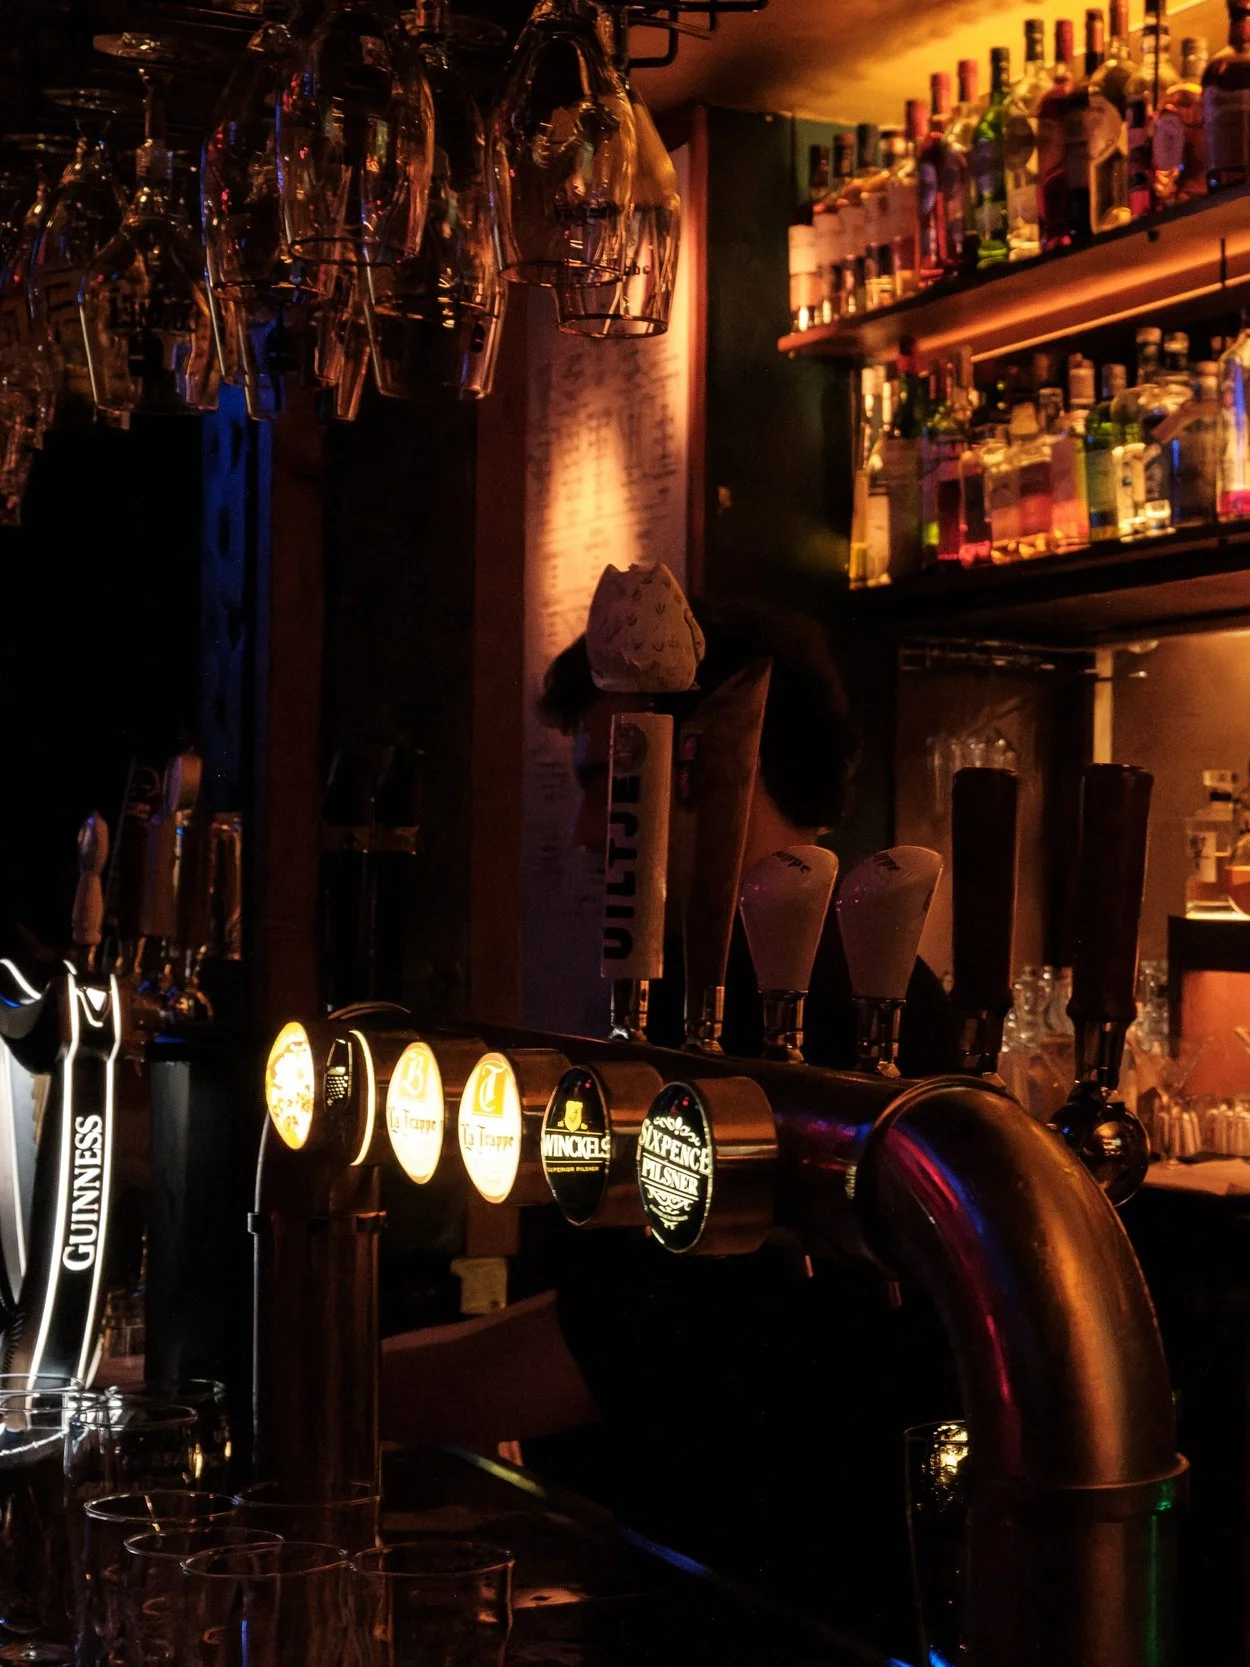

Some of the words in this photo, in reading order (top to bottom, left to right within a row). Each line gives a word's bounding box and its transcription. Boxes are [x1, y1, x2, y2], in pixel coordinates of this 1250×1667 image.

[603, 776, 640, 959] UILTJE
[387, 1107, 400, 1134] La
[402, 1109, 437, 1136] Trappe
[460, 1122, 474, 1151] La
[477, 1124, 514, 1154] Trappe
[543, 1134, 611, 1159] WINCKELS
[638, 1118, 713, 1176] SIXPENCE
[62, 1114, 103, 1271] GUINNESS
[642, 1156, 699, 1196] PILSNER
